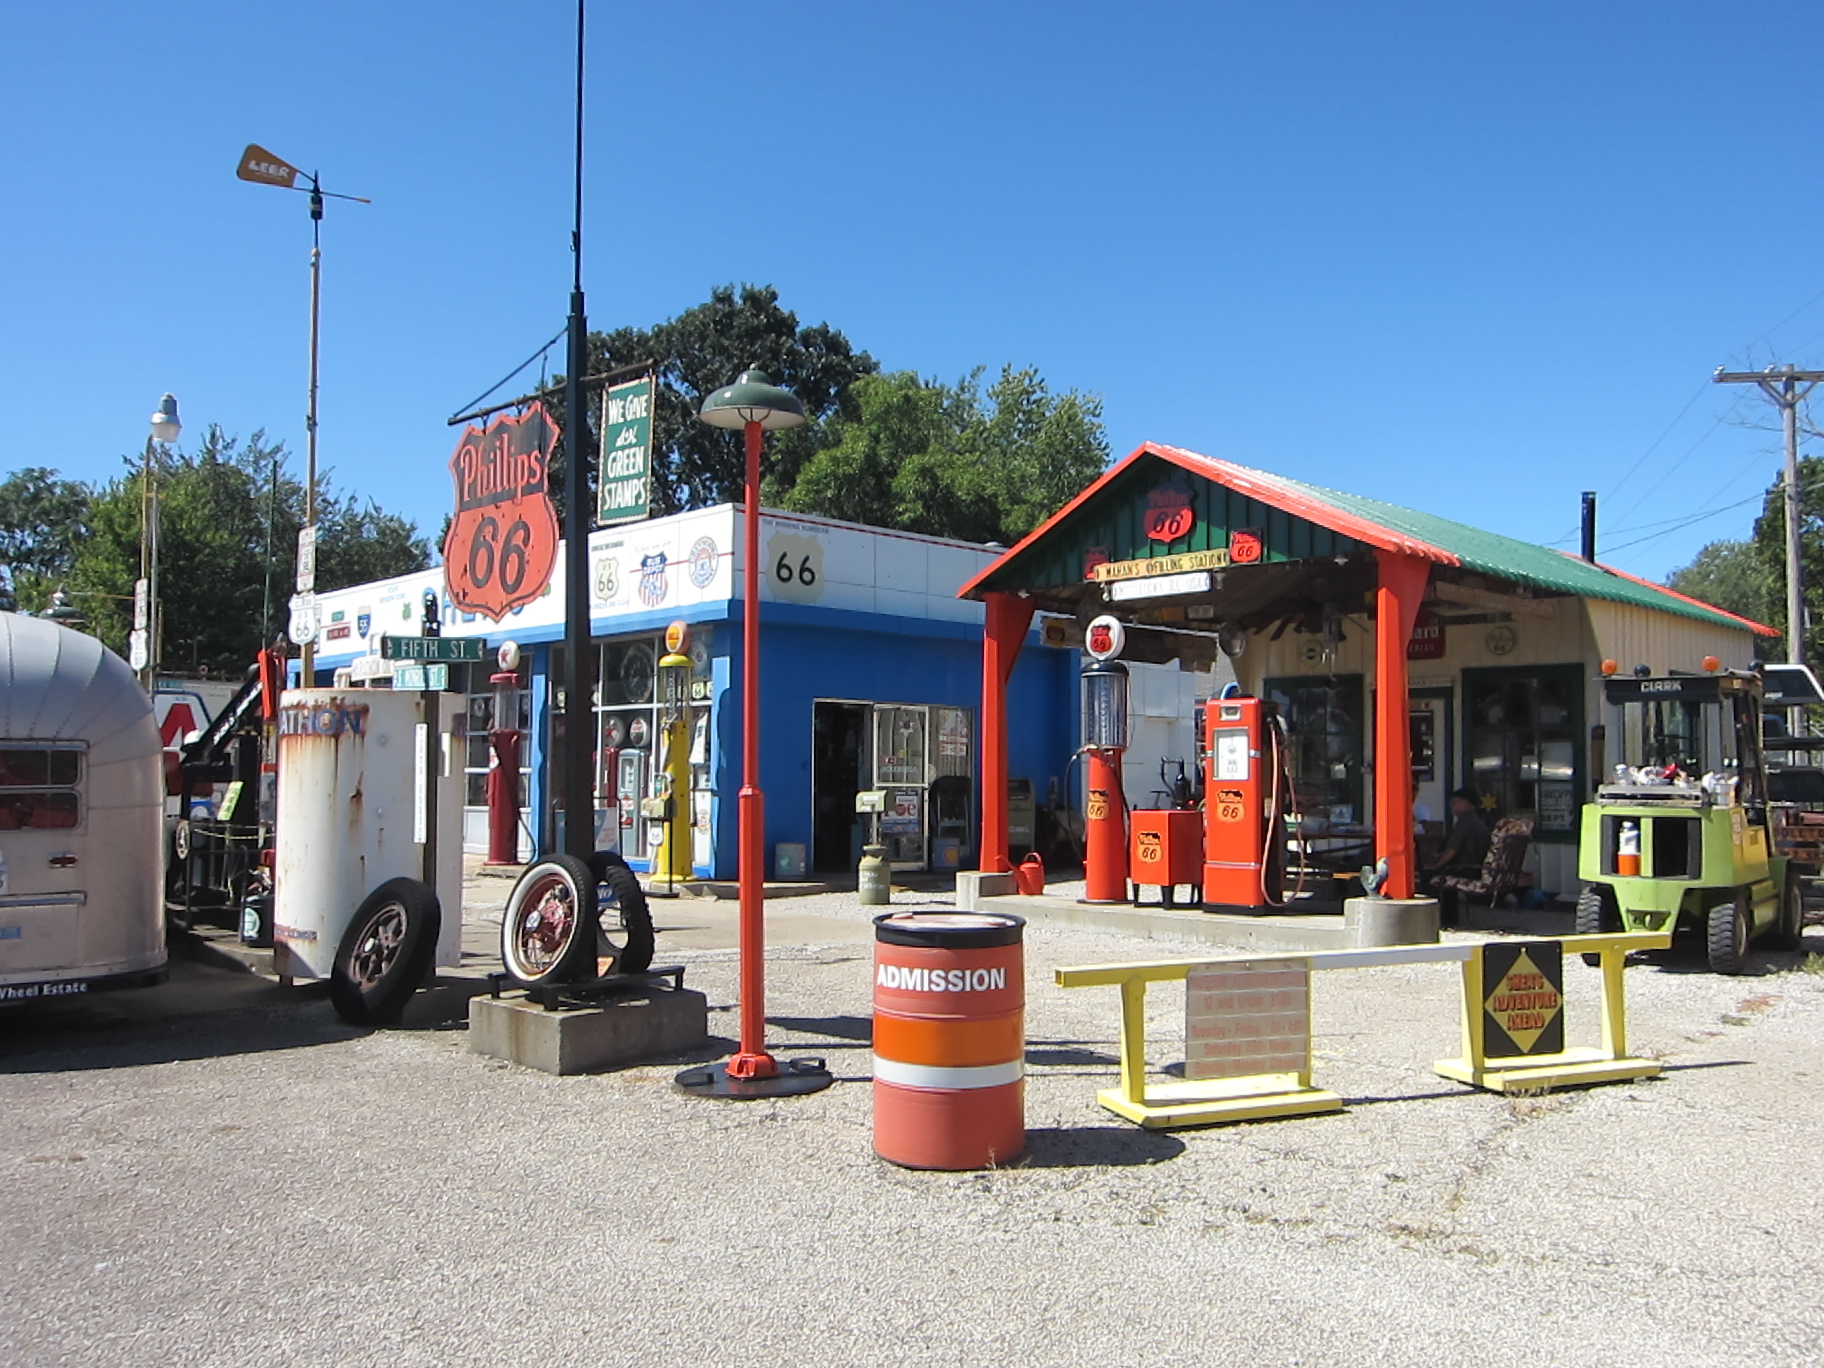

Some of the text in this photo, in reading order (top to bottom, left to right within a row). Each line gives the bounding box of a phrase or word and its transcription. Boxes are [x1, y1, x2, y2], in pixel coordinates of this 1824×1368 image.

[608, 394, 649, 425] WE GIVE
[460, 433, 542, 505] Phillips
[607, 446, 645, 478] GREEN
[603, 477, 646, 511] STAMPS
[1153, 511, 1184, 535] 66
[469, 516, 531, 594] 66
[1237, 545, 1253, 558] 66
[776, 551, 816, 586] 66
[1190, 552, 1222, 571] STATION
[598, 573, 615, 593] 66
[296, 622, 310, 639] 66
[401, 639, 470, 658] FIFTH ST.
[1640, 680, 1682, 692] CLARK
[1089, 805, 1104, 816] 66
[1221, 805, 1239, 819] 66
[1141, 847, 1157, 860] 66
[877, 964, 1006, 992] ADMISSION
[43, 982, 88, 996] Estate
[1493, 991, 1557, 1012] ADVENTURE
[1507, 1013, 1545, 1031] AHEAD
